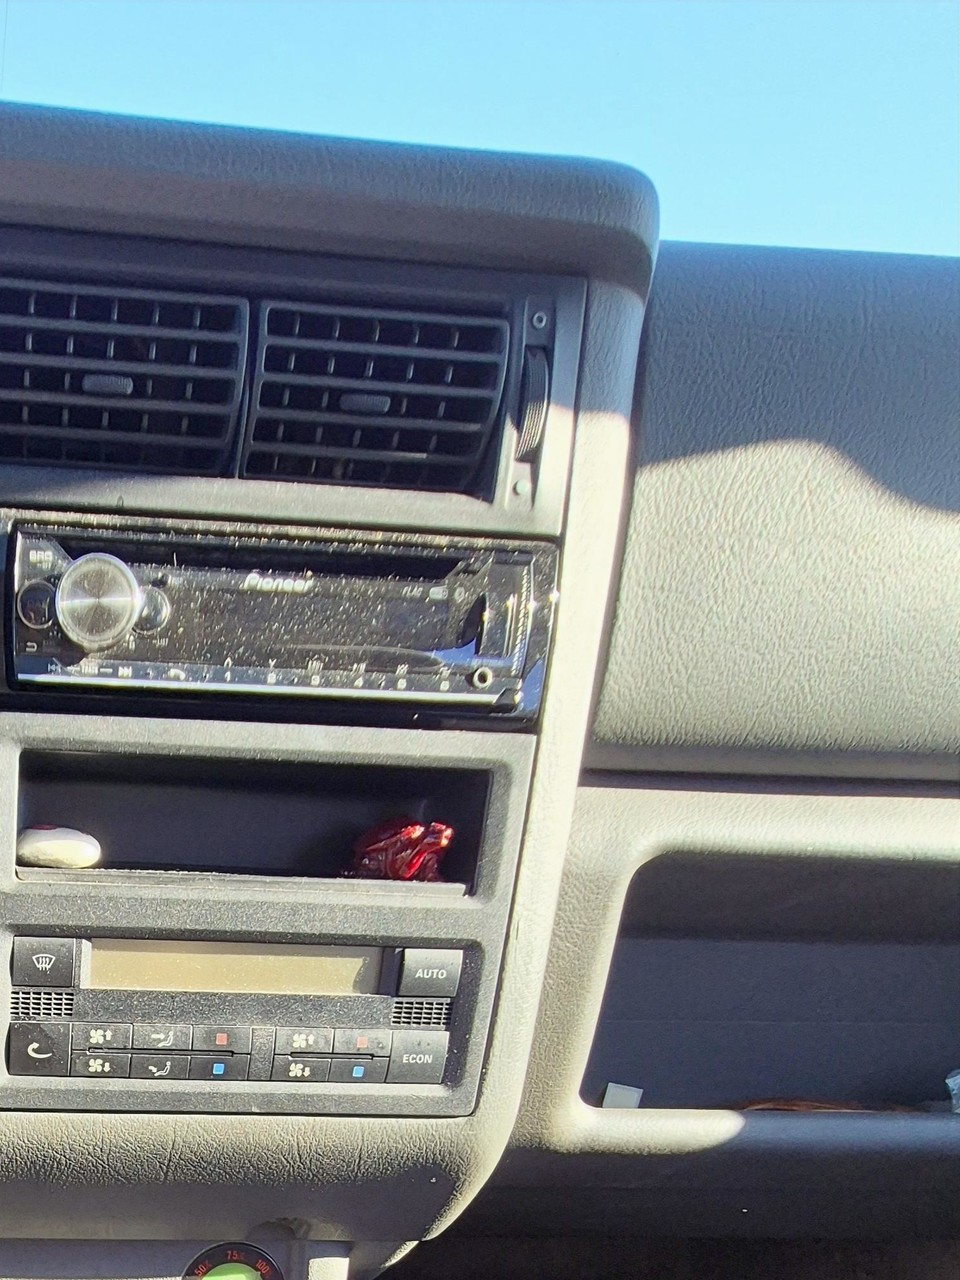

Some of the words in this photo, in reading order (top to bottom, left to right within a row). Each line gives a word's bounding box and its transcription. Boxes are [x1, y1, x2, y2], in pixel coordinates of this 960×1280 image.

[243, 571, 316, 594] Pioneer
[414, 968, 447, 979] AUTO
[402, 1053, 433, 1064] ECON
